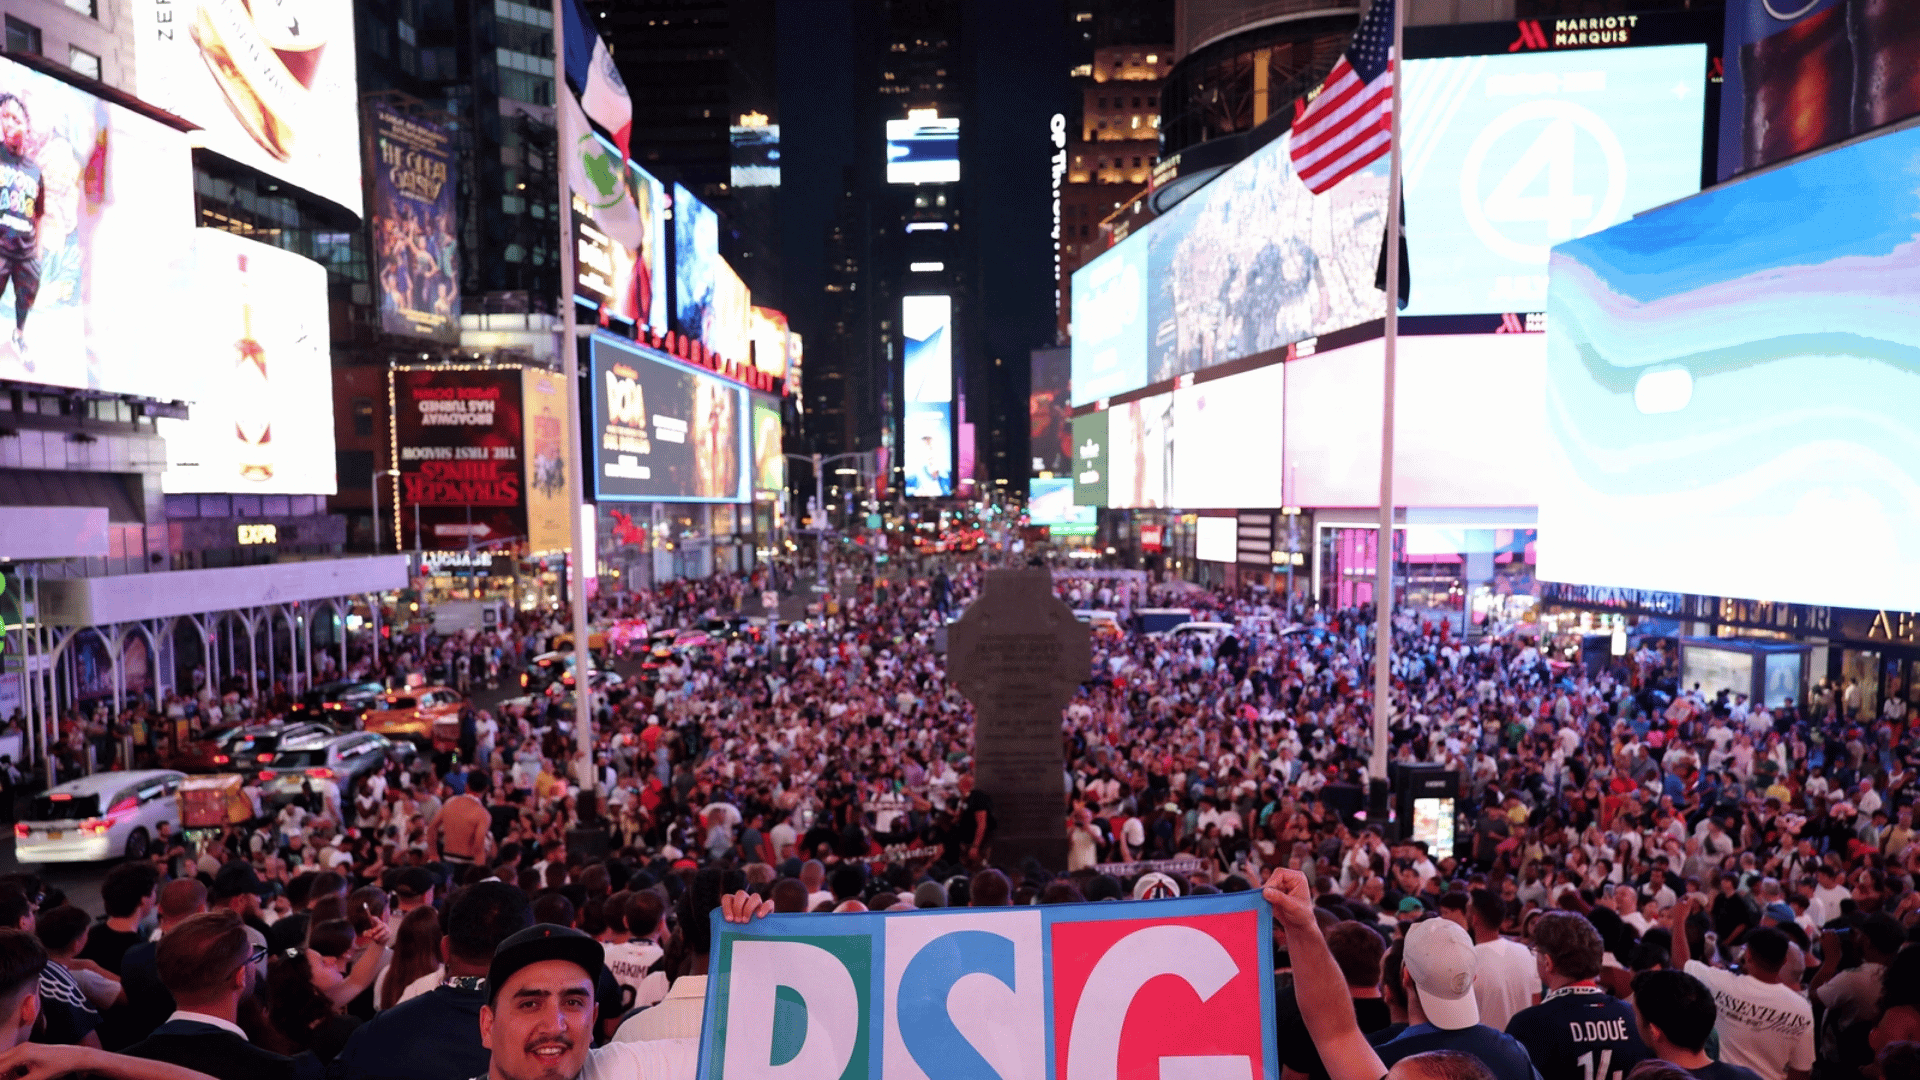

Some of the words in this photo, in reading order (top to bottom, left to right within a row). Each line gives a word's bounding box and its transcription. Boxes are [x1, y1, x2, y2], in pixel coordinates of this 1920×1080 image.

[1555, 16, 1638, 32] MARRIOTT
[1555, 30, 1628, 46] MARQUIS
[1569, 1016, 1629, 1043] D.DOUÉ
